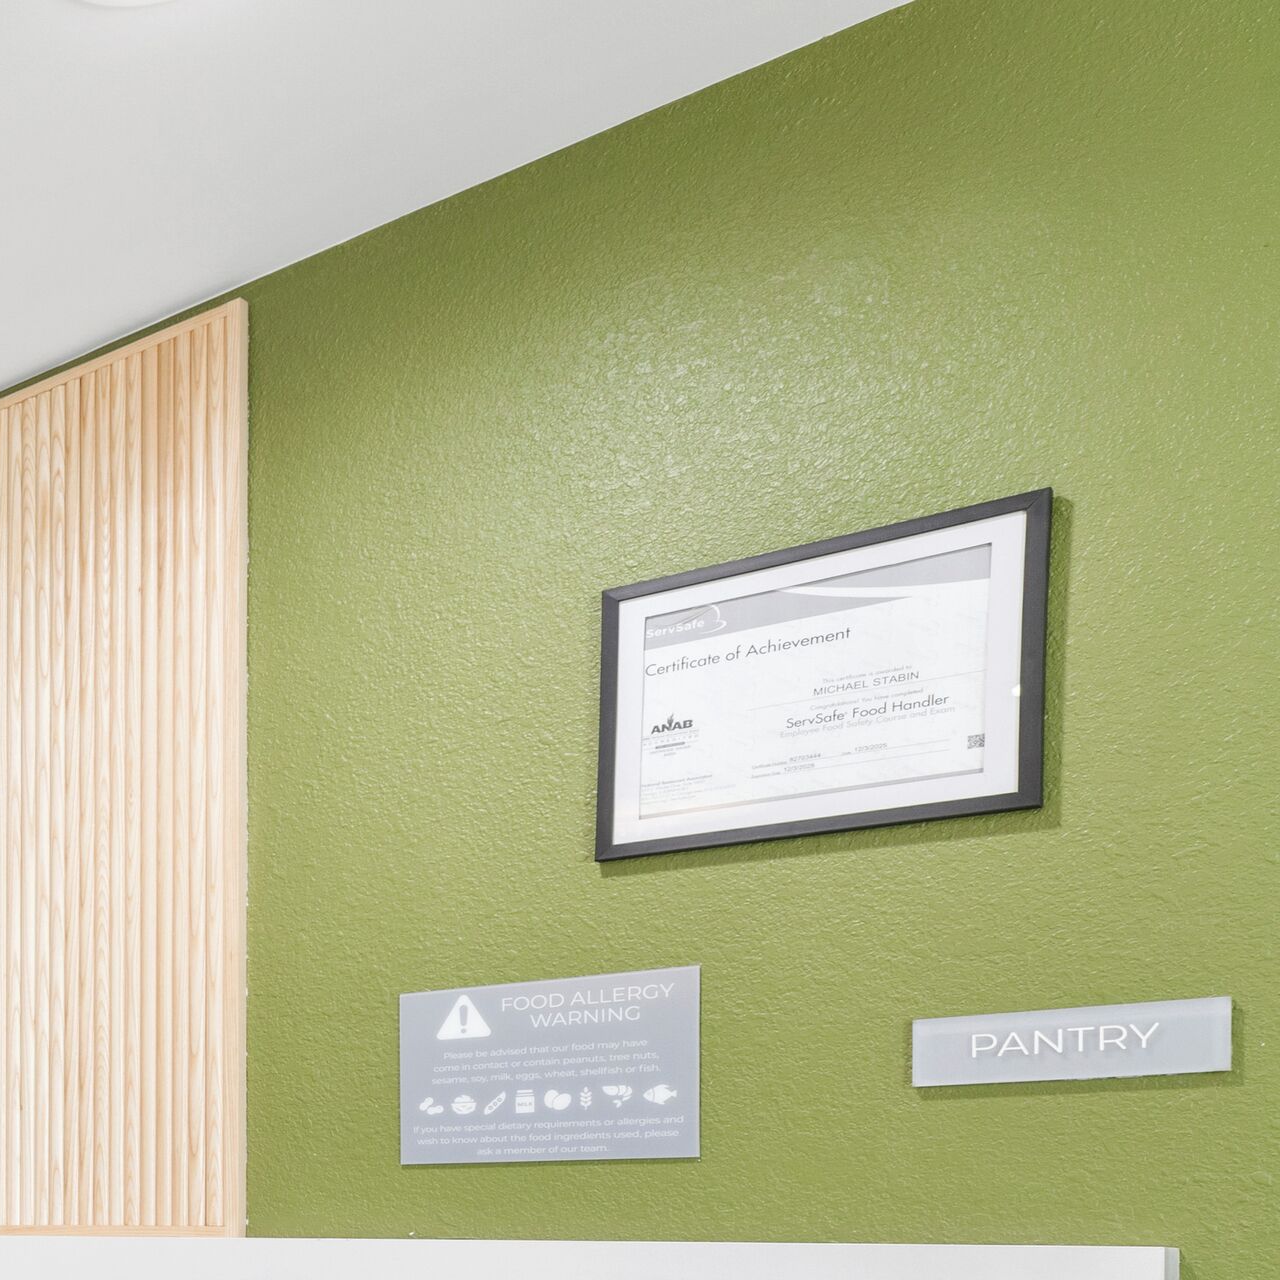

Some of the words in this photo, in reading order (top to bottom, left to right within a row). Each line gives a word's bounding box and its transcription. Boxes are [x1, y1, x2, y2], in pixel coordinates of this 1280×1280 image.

[645, 620, 705, 639] ServSafe
[645, 654, 721, 677] Certificate
[726, 645, 742, 661] of
[745, 627, 852, 657] Achievement
[813, 680, 869, 697] MICHAEL
[873, 671, 920, 687] STABIN
[852, 702, 888, 718] Food
[892, 694, 950, 712] Handler
[651, 719, 693, 735] ANAB
[780, 726, 820, 739] Employee
[822, 720, 844, 732] Food
[846, 718, 873, 730] Safety
[876, 712, 908, 724] Course
[910, 709, 928, 718] and
[930, 705, 956, 716] Exam
[501, 993, 565, 1013] FOOD
[569, 982, 676, 1008] ALLERGY
[529, 1005, 641, 1029] WARNING
[444, 1051, 473, 1060] Please
[476, 1049, 488, 1058] be
[490, 1047, 527, 1057] advised
[529, 1045, 549, 1055] that
[552, 1045, 568, 1053] our
[571, 1042, 595, 1052] food
[597, 1041, 620, 1051] may
[622, 1039, 648, 1048] have
[970, 1021, 1160, 1059] PANTRY
[433, 1064, 459, 1073] come
[462, 1063, 471, 1071] in
[472, 1060, 508, 1070] contact
[523, 1058, 560, 1067] contain
[609, 1053, 630, 1061] tree
[580, 1066, 623, 1076] shellfish
[625, 1065, 636, 1073] or
[420, 1126, 438, 1135] you
[439, 1124, 461, 1133] have
[463, 1121, 497, 1132] special
[498, 1120, 531, 1131] dietary
[534, 1118, 602, 1129] requirements
[617, 1115, 660, 1127] allergies
[662, 1114, 684, 1124] and
[416, 1136, 438, 1145] wish
[440, 1136, 450, 1145] to
[452, 1135, 477, 1145] know
[480, 1134, 508, 1143] about
[510, 1133, 527, 1142] the
[528, 1132, 551, 1142] food
[554, 1129, 611, 1142] ingredients
[644, 1127, 679, 1139] please
[477, 1147, 491, 1156] ask
[504, 1145, 546, 1155] member
[548, 1145, 559, 1154] of
